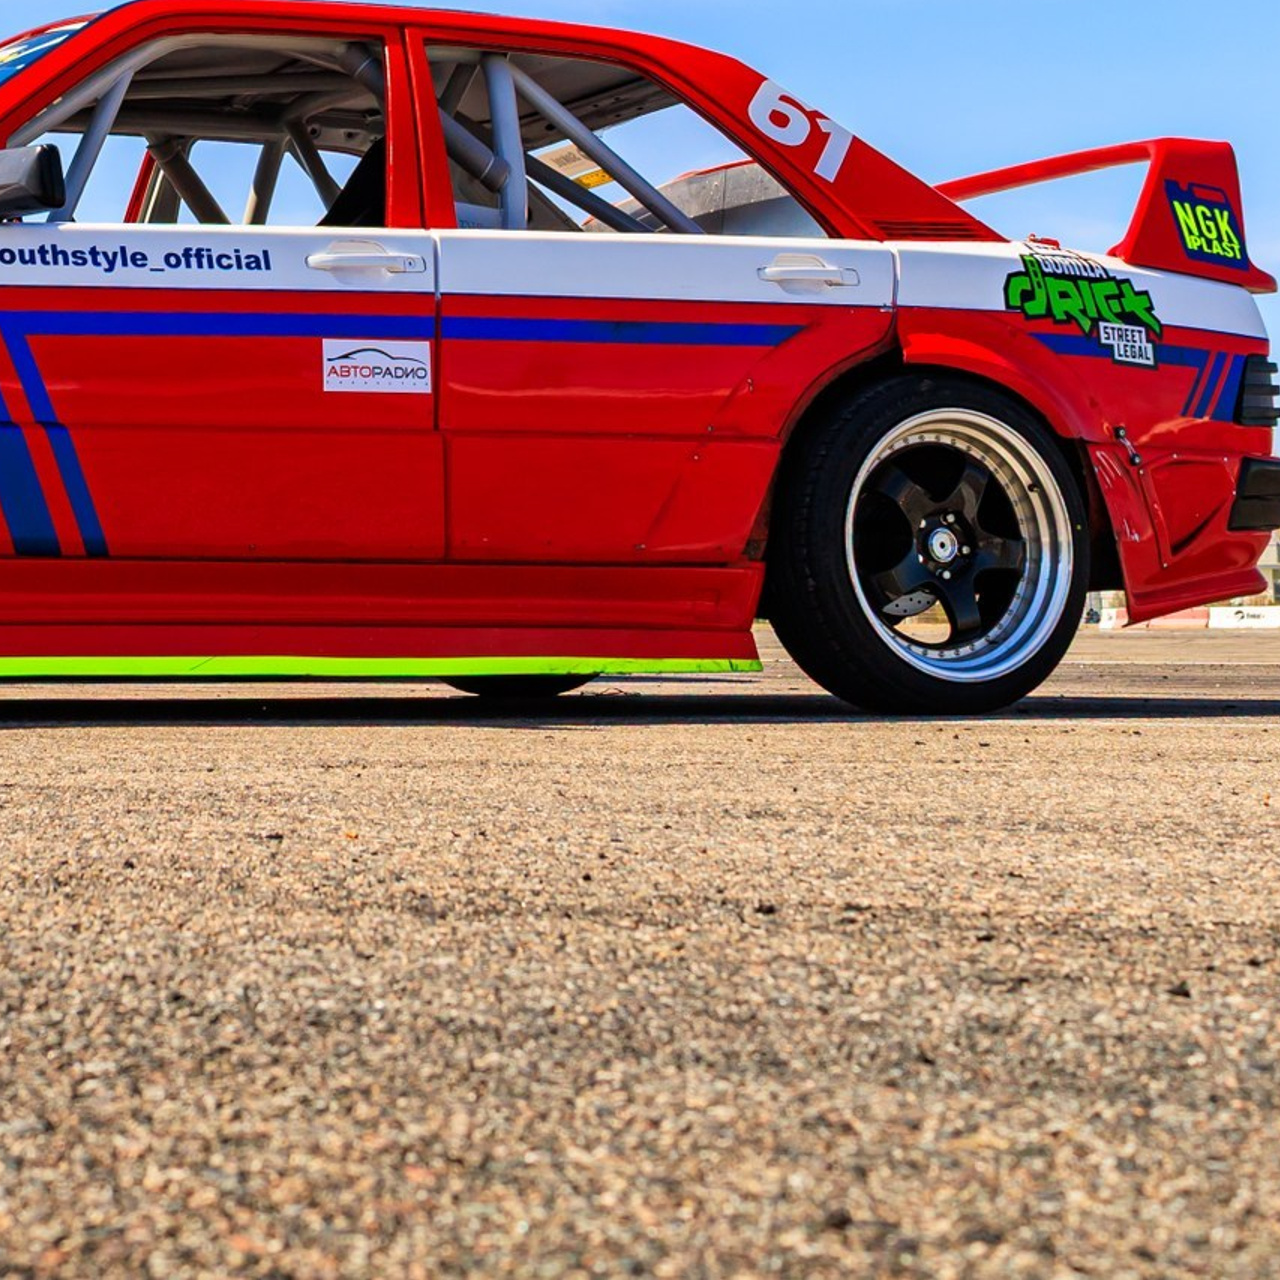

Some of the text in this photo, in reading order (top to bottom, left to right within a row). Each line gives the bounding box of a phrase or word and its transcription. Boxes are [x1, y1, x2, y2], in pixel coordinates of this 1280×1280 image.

[748, 79, 854, 183] 61
[1173, 200, 1239, 250] NGK
[1189, 234, 1242, 260] PLAST
[1034, 255, 1109, 280] GORILLA
[1103, 324, 1144, 344] STREET
[1116, 342, 1152, 361] LEGAL
